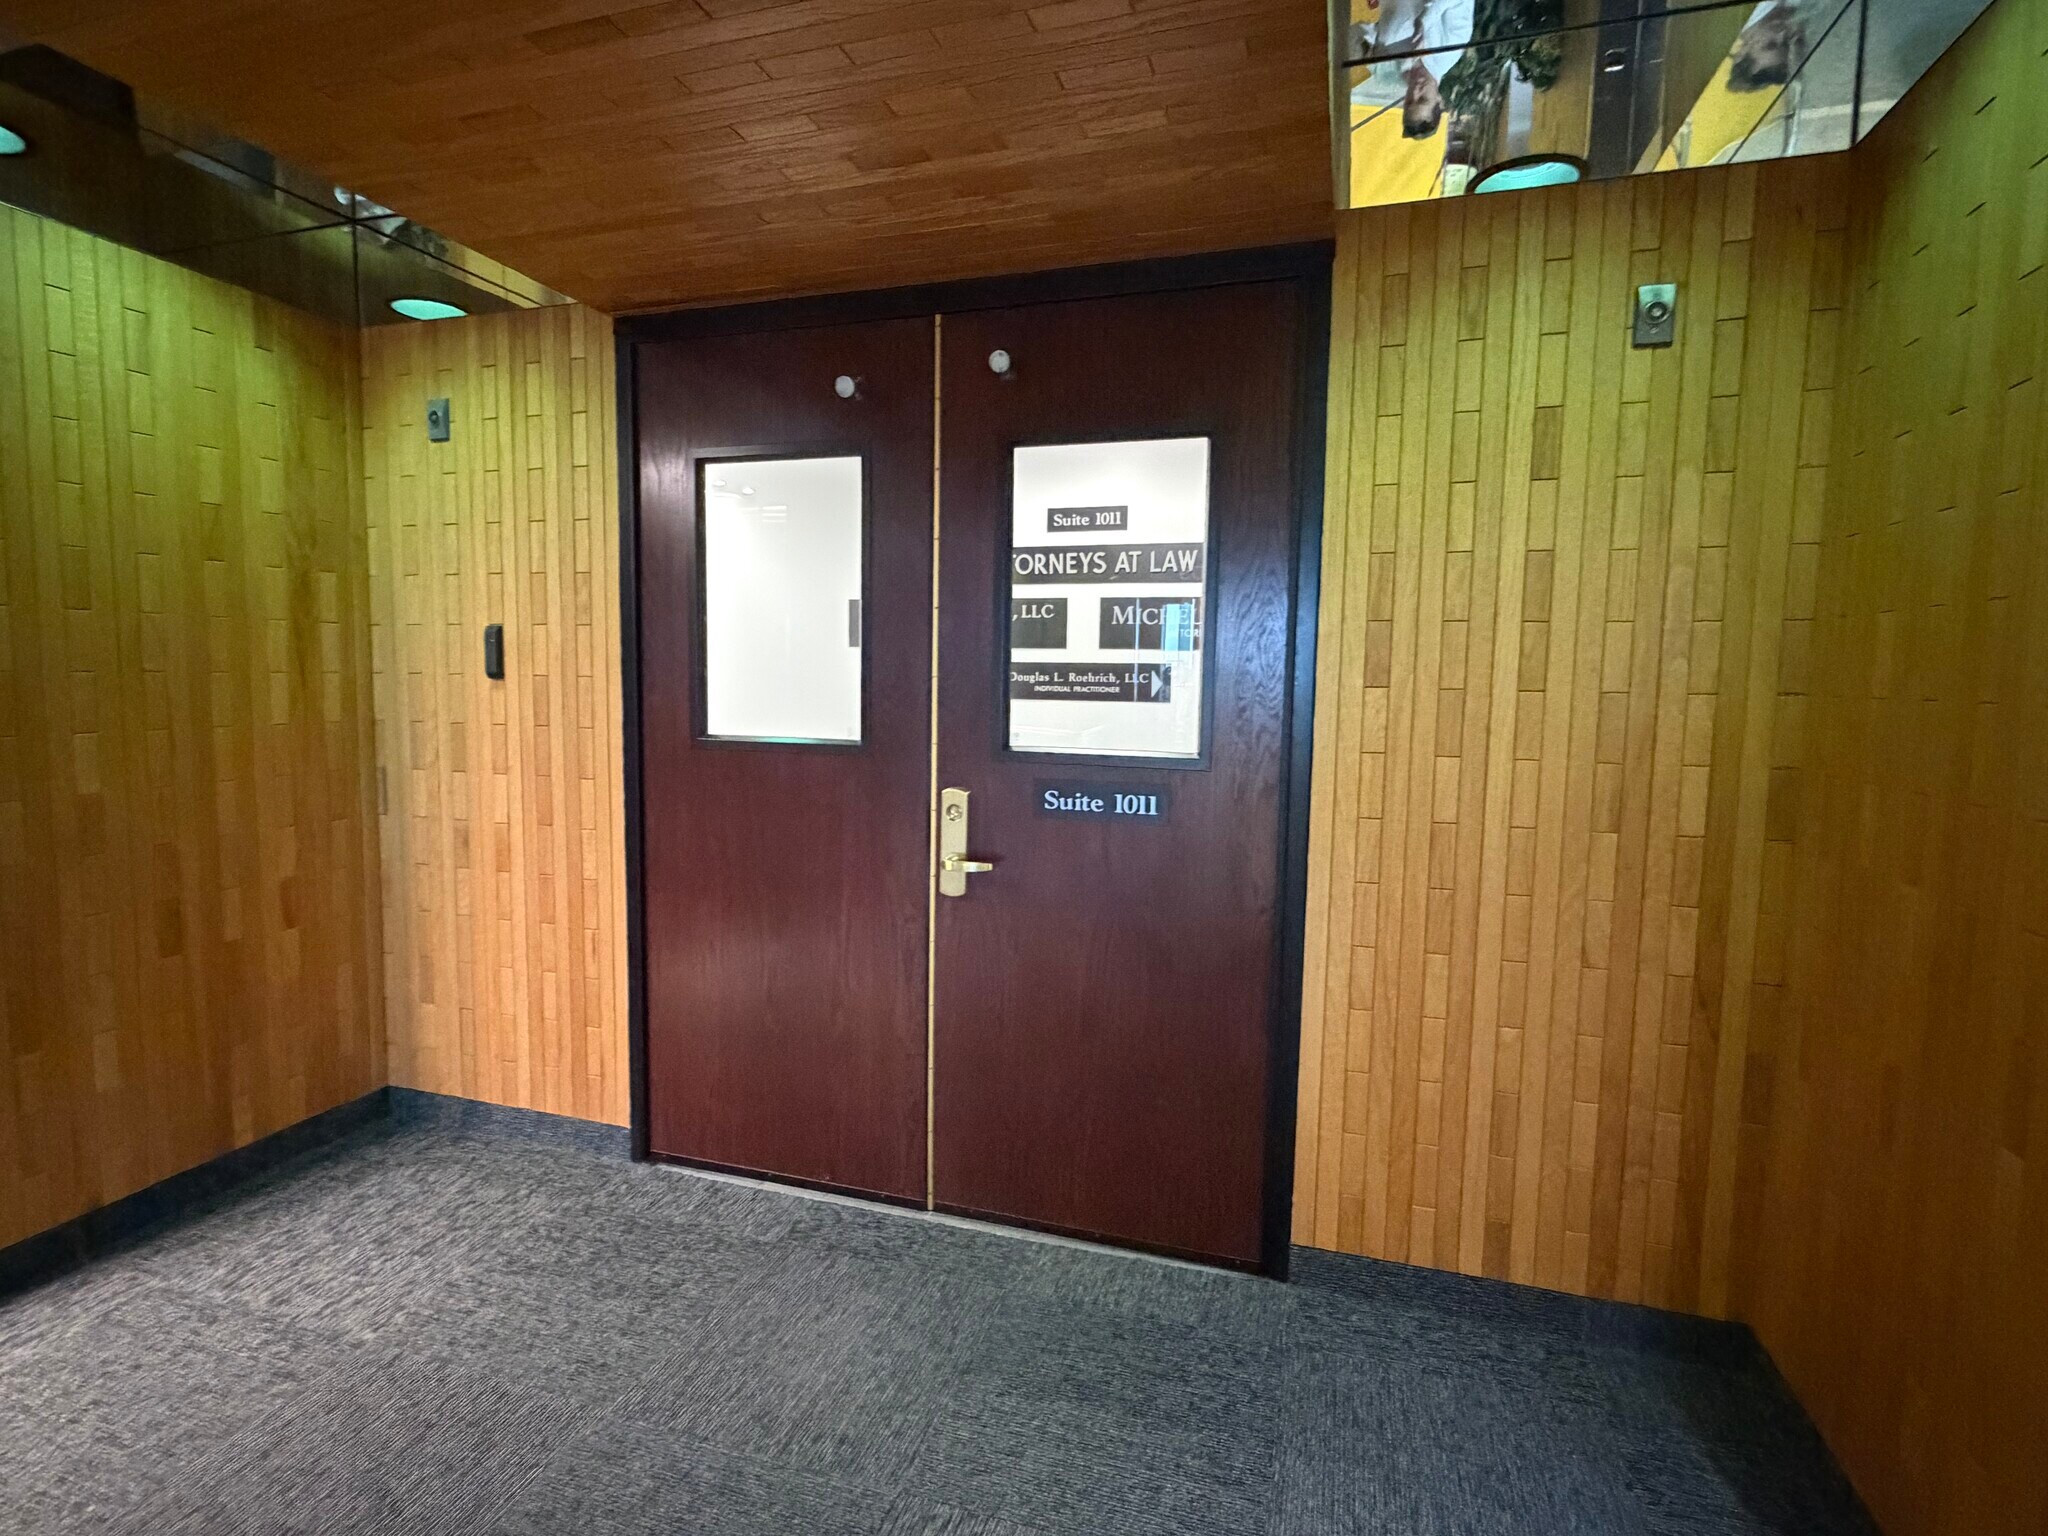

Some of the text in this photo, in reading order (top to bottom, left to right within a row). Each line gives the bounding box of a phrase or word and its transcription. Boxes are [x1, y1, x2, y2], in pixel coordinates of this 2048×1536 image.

[1053, 511, 1122, 527] Suite 1011
[1114, 551, 1142, 574] AT
[1150, 549, 1199, 573] LAW
[1010, 671, 1050, 684] Douglas
[1068, 672, 1120, 685] Roehrich,
[1124, 673, 1150, 684] LLC
[1033, 685, 1121, 694] INDIVIDUAL PRACTITIONER
[1044, 789, 1159, 816] Suite 1011
